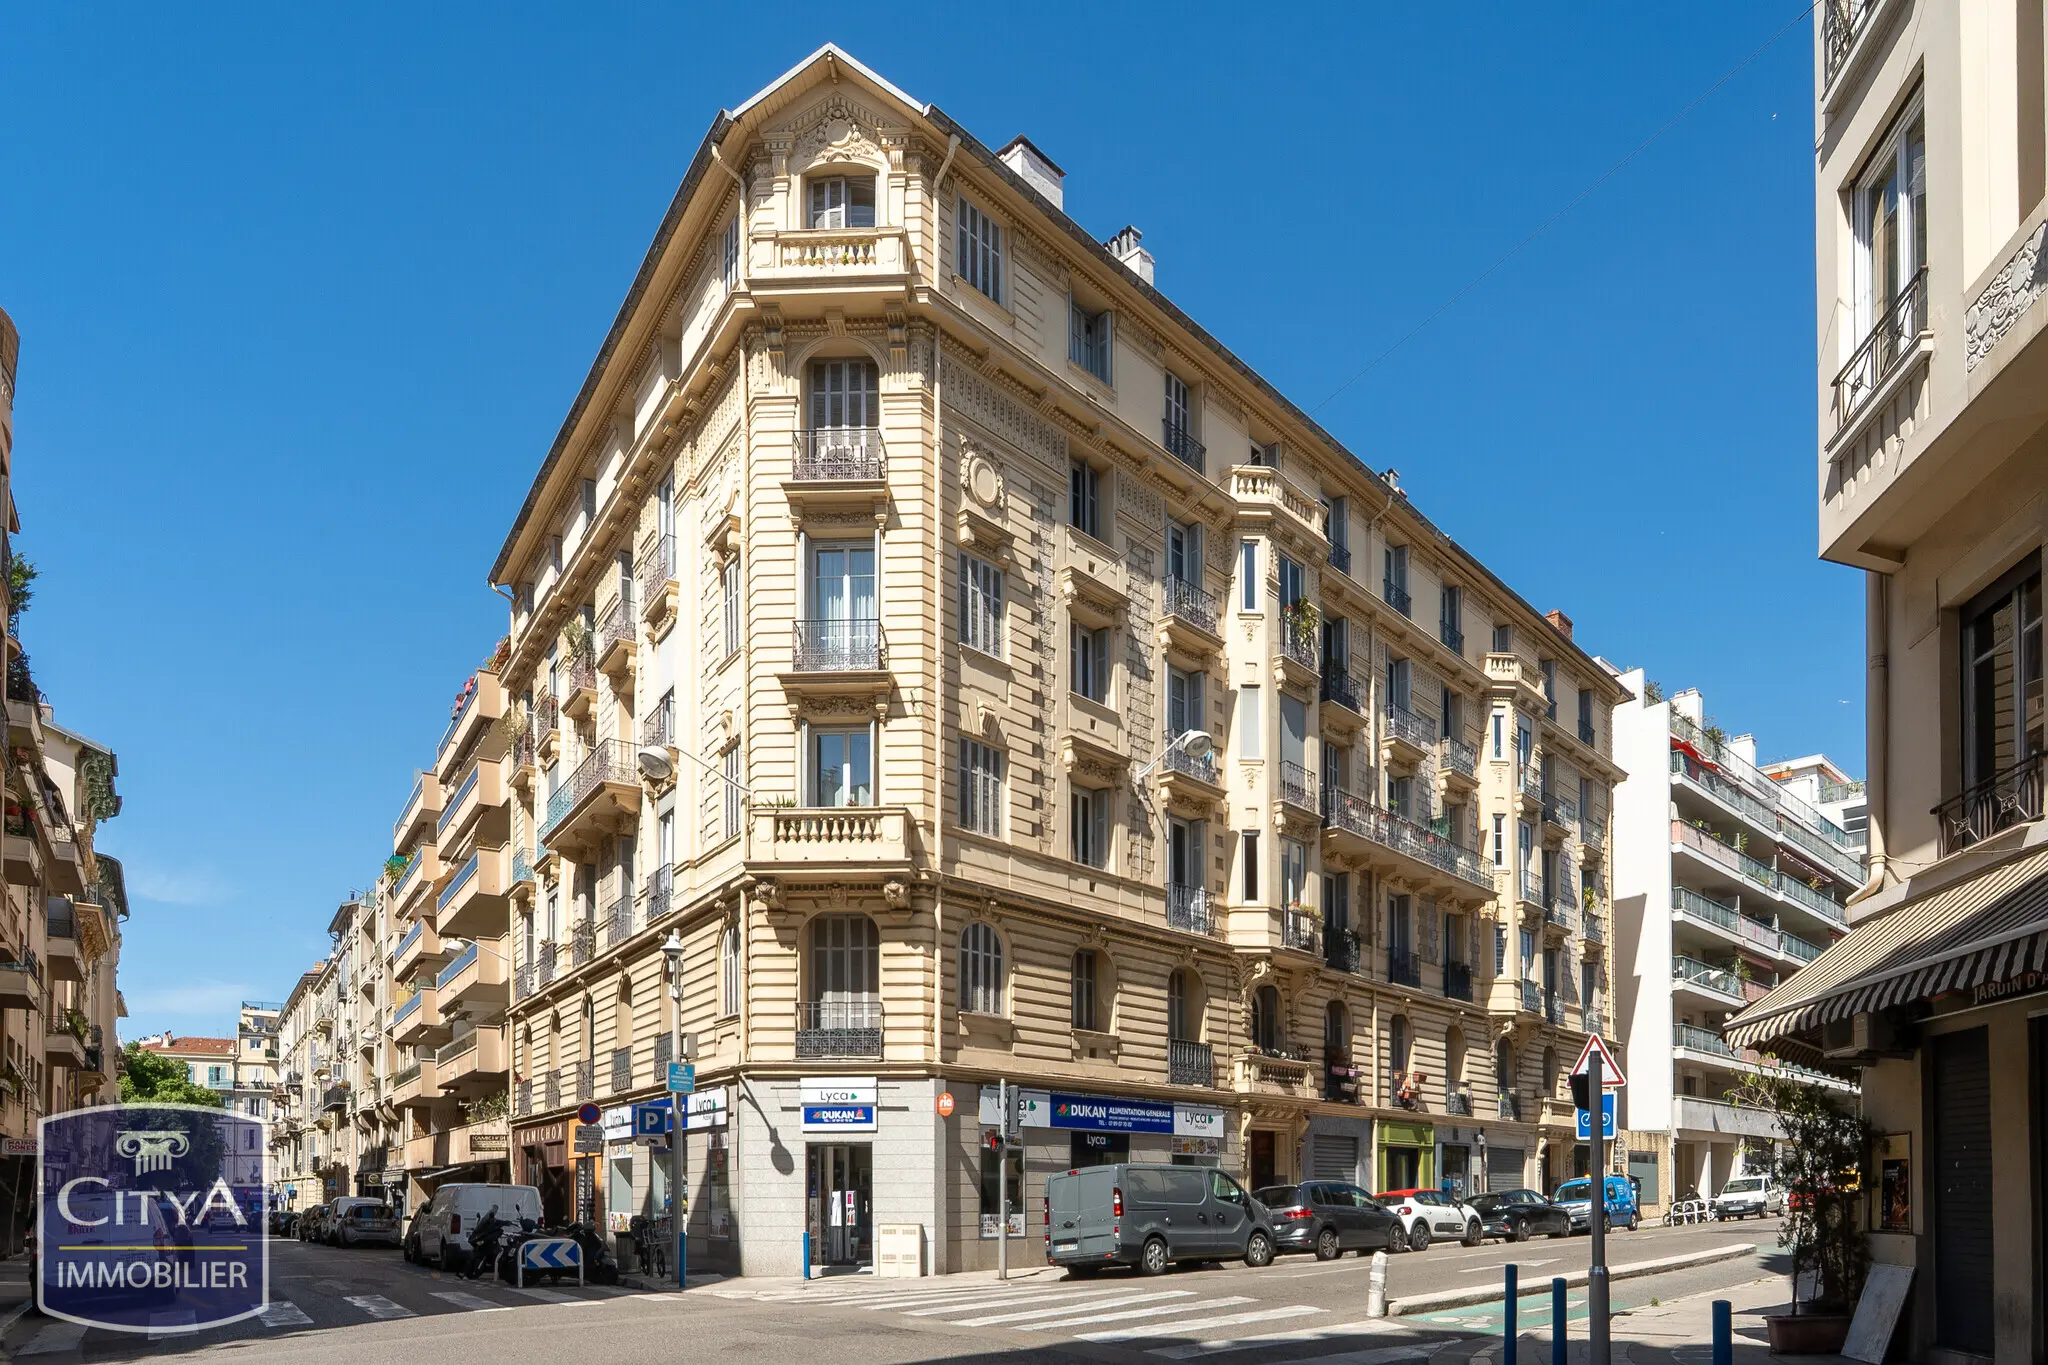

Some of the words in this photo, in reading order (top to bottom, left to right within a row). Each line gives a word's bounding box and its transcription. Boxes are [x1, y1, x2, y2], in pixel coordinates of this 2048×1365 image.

[1973, 976, 2022, 1005] JARDIN
[820, 1090, 848, 1104] Lyca
[821, 1110, 855, 1119] DUKAN
[1071, 1104, 1106, 1118] DUKAN
[1109, 1107, 1145, 1116] ALIMENTATION
[1185, 1109, 1207, 1125] Lyca
[645, 1112, 659, 1130] P
[1087, 1133, 1107, 1147] Lyca
